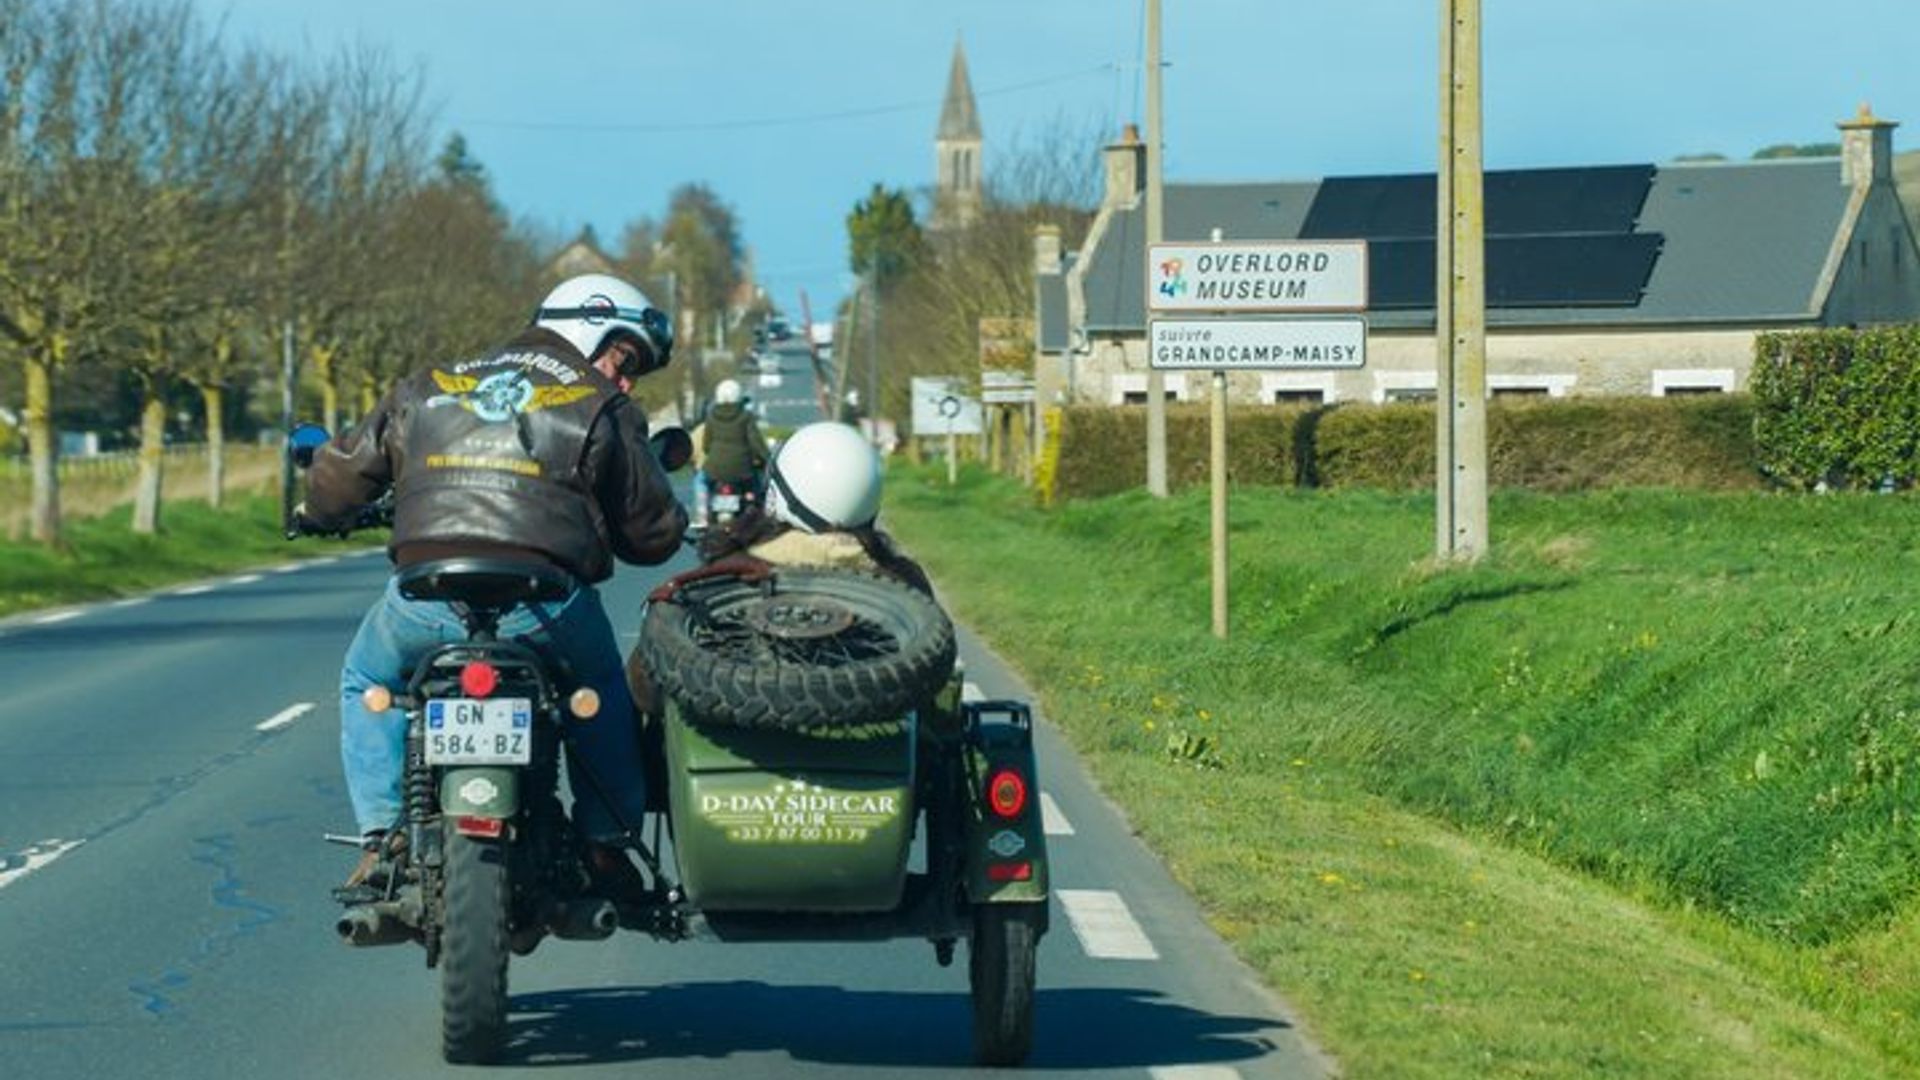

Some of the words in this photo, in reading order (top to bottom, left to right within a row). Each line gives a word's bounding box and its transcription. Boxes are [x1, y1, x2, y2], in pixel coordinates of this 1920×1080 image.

[1196, 252, 1330, 274] OVERLORD
[1196, 280, 1307, 299] MUSEUM
[1157, 328, 1213, 342] suivre
[1157, 345, 1357, 362] GRANDCAMP-MAISY
[456, 704, 485, 725] GN
[702, 795, 778, 812] D-DAY
[785, 795, 896, 813] SIDECAR
[772, 812, 827, 826] TOUR
